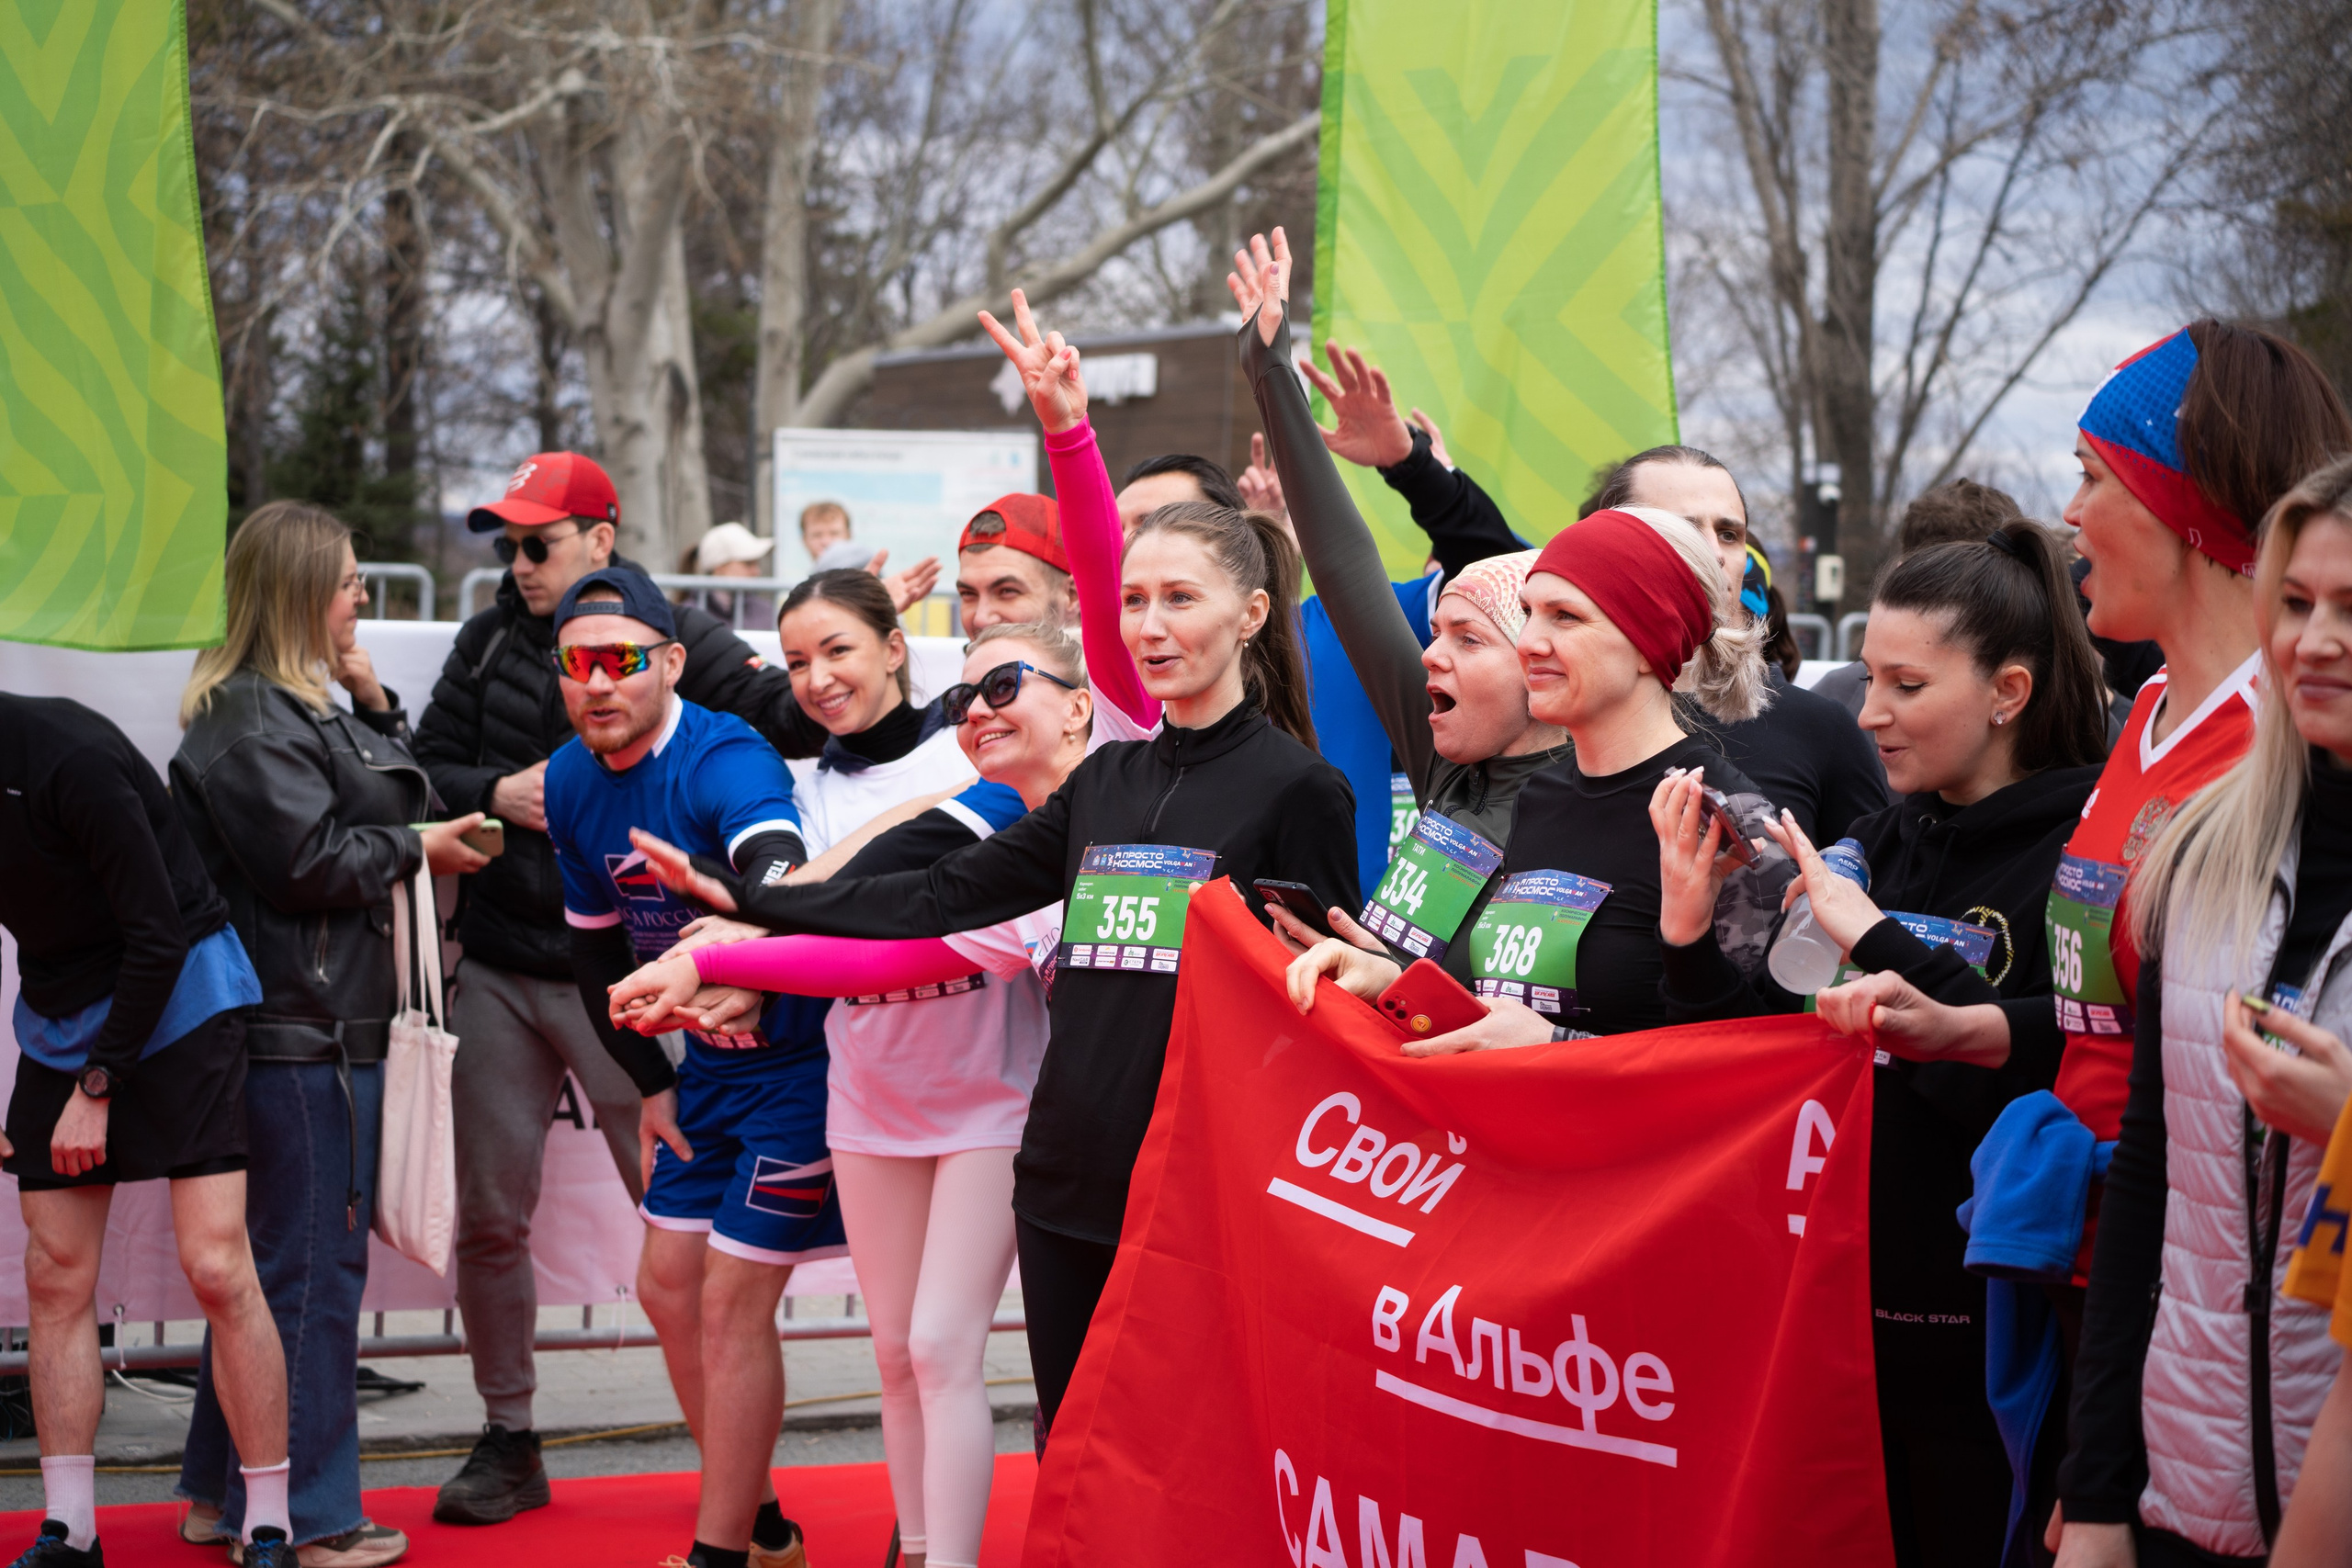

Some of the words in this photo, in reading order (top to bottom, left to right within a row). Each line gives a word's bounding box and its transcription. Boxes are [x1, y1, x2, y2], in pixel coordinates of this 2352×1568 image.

[1113, 859, 1164, 869] КОСМОС
[1124, 852, 1164, 860] ПРОСТО
[1380, 857, 1429, 917] 334
[1516, 886, 1556, 897] КОСМОС
[1525, 877, 1559, 886] ПРОСТО
[1097, 895, 1159, 941] 355
[1484, 924, 1543, 976] 368
[2052, 923, 2083, 994] 356
[1295, 1091, 1467, 1213] Свой
[1875, 1308, 1925, 1323] BLACK
[1928, 1314, 1971, 1324] STAR
[1373, 1284, 1409, 1352] в
[1416, 1284, 1676, 1435] Альфе
